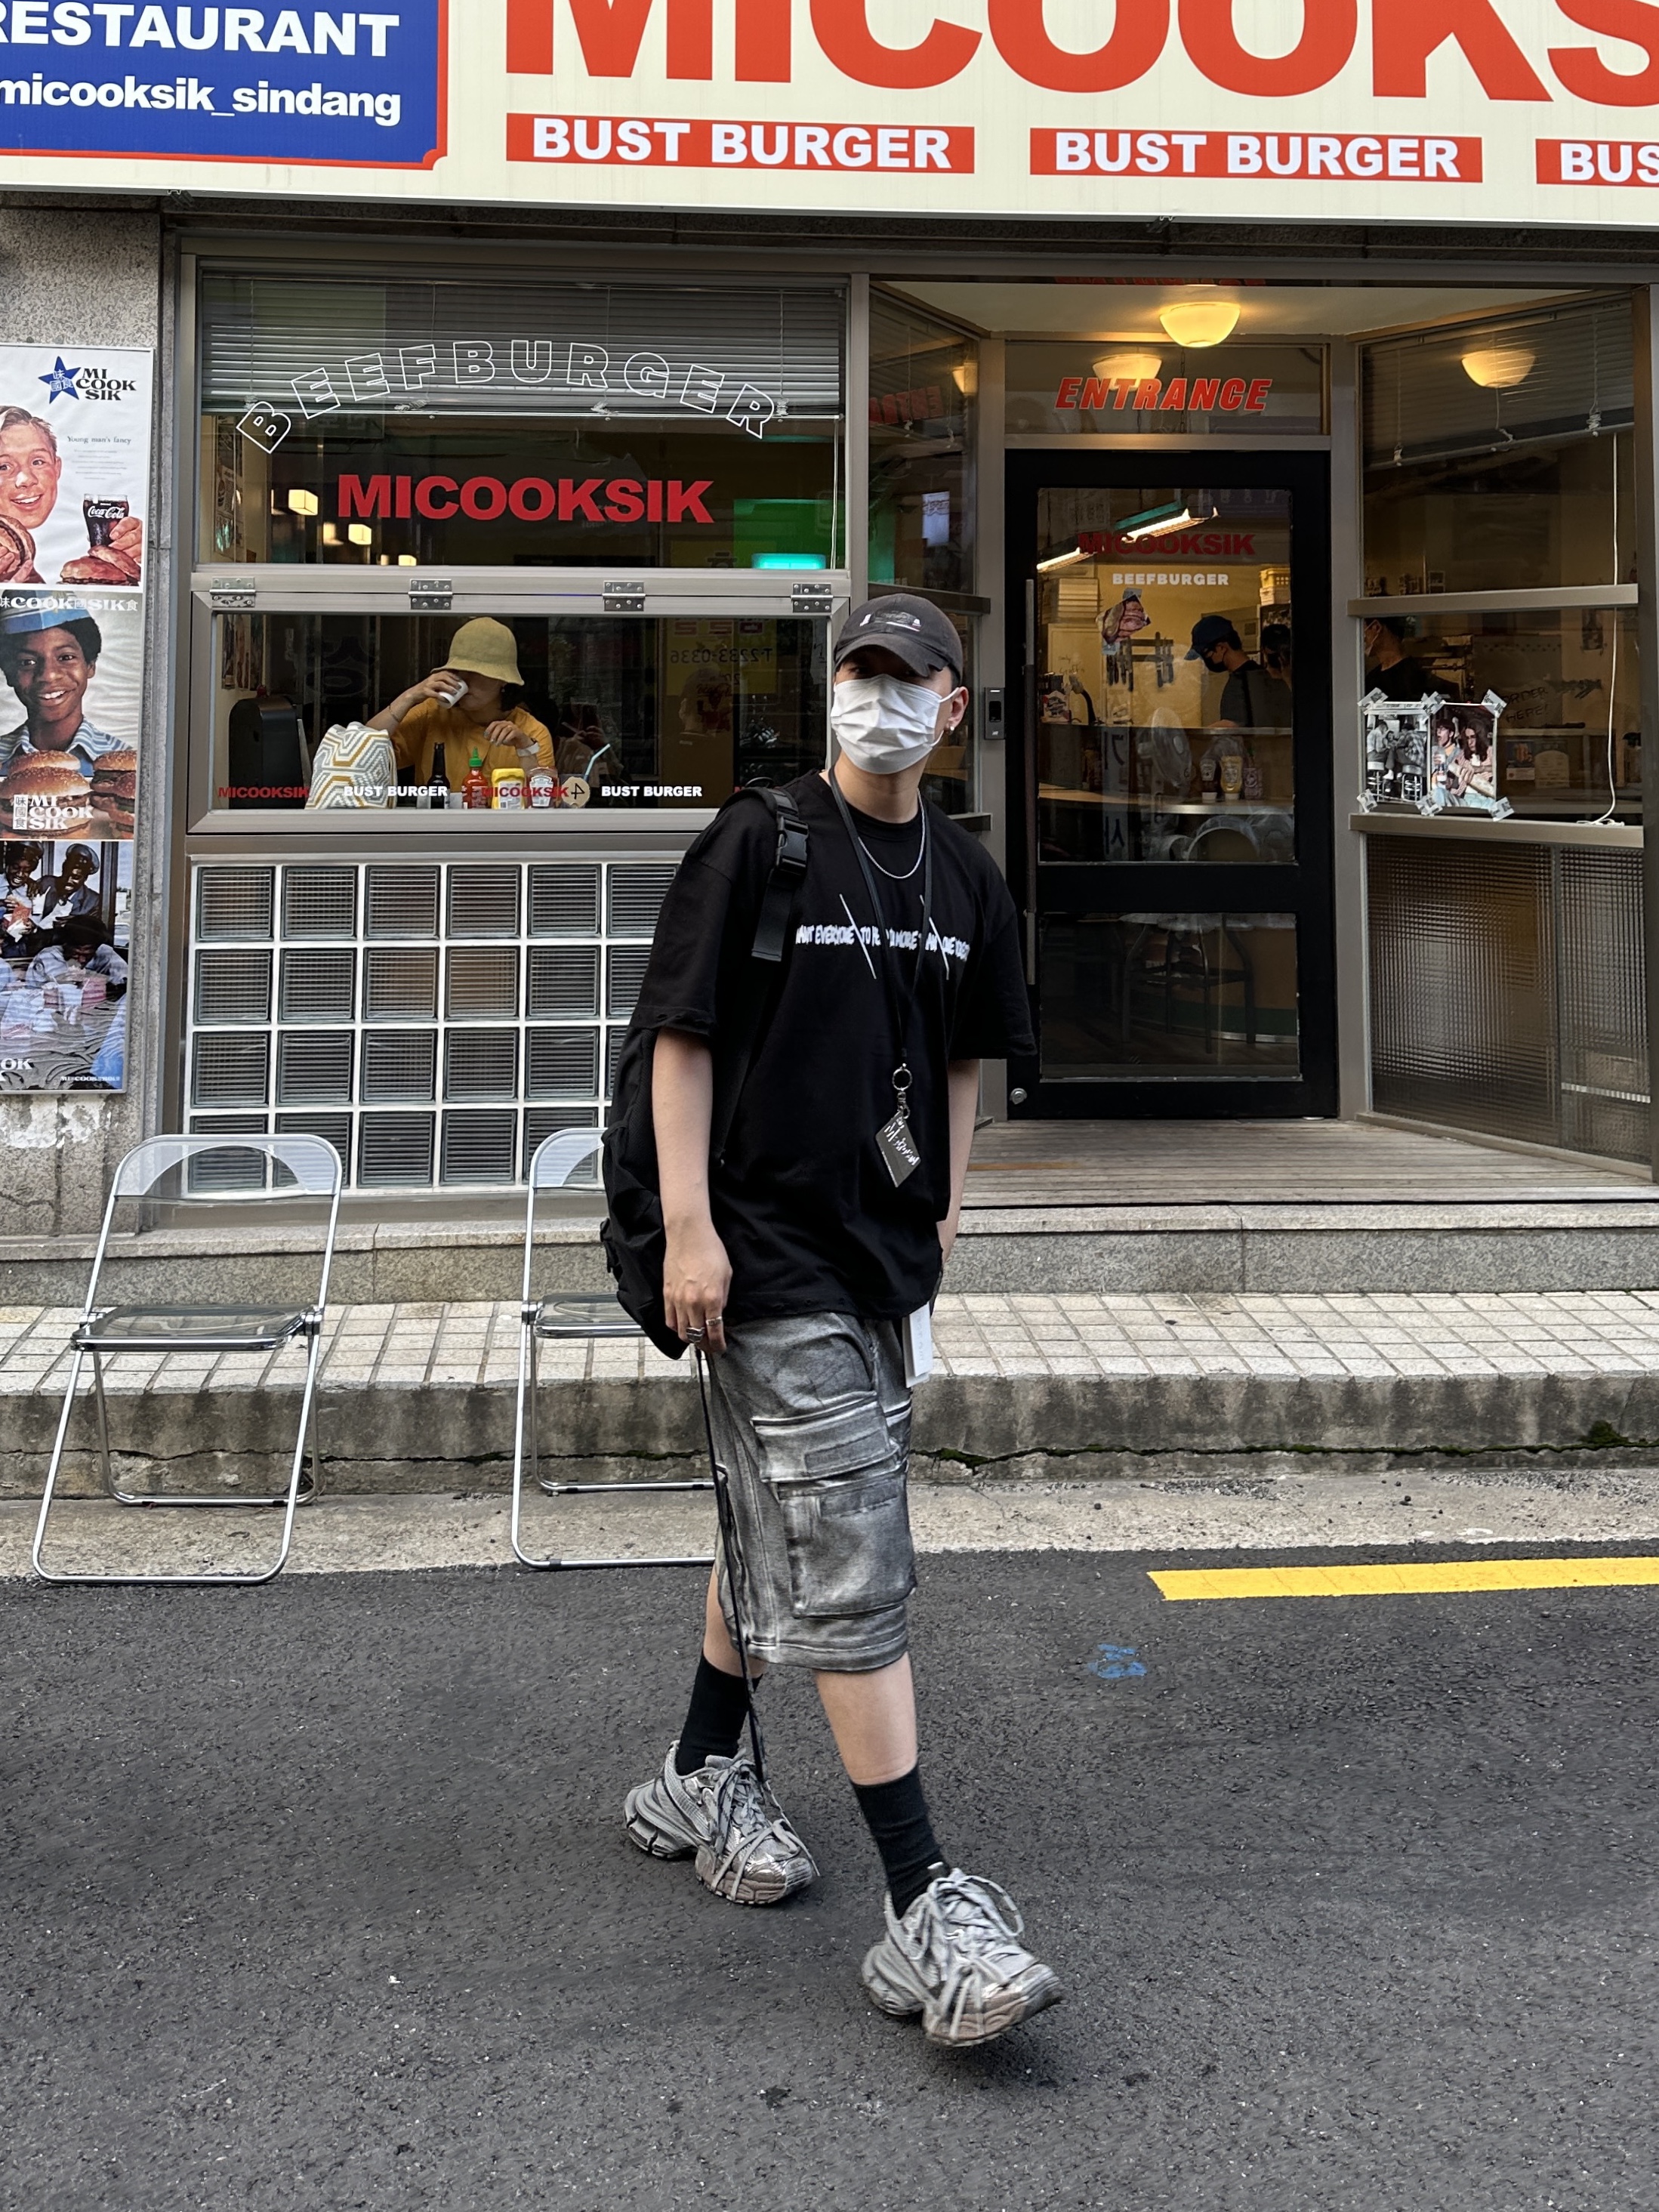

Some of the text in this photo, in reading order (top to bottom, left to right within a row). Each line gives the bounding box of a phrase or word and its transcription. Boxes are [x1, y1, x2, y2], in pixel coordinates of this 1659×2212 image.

[0, 1, 400, 57] ESTAURANT
[532, 117, 952, 169] BUST BURGER
[1056, 131, 1461, 177] BUST BURGER
[82, 368, 107, 379] MI
[76, 378, 137, 391] COOK
[85, 390, 122, 400] SIK
[236, 340, 775, 453] BEEFBURGER
[1055, 377, 1273, 411] ENTRANCE
[67, 436, 88, 444] Young
[113, 437, 131, 445] fancy
[337, 474, 714, 523] MICOOKSIK
[1078, 532, 1256, 556] MICOOKSIK
[1112, 573, 1229, 585] BEEFBURGER
[218, 786, 310, 799] MICOOKSIK
[344, 785, 384, 797] BUST
[387, 785, 448, 797] BURGER
[483, 786, 569, 797] MICOOKSIK
[601, 785, 640, 797] BUST
[643, 785, 702, 797] BURGER
[29, 794, 57, 807] MI
[29, 807, 94, 819] COOK
[29, 818, 68, 830] SIK
